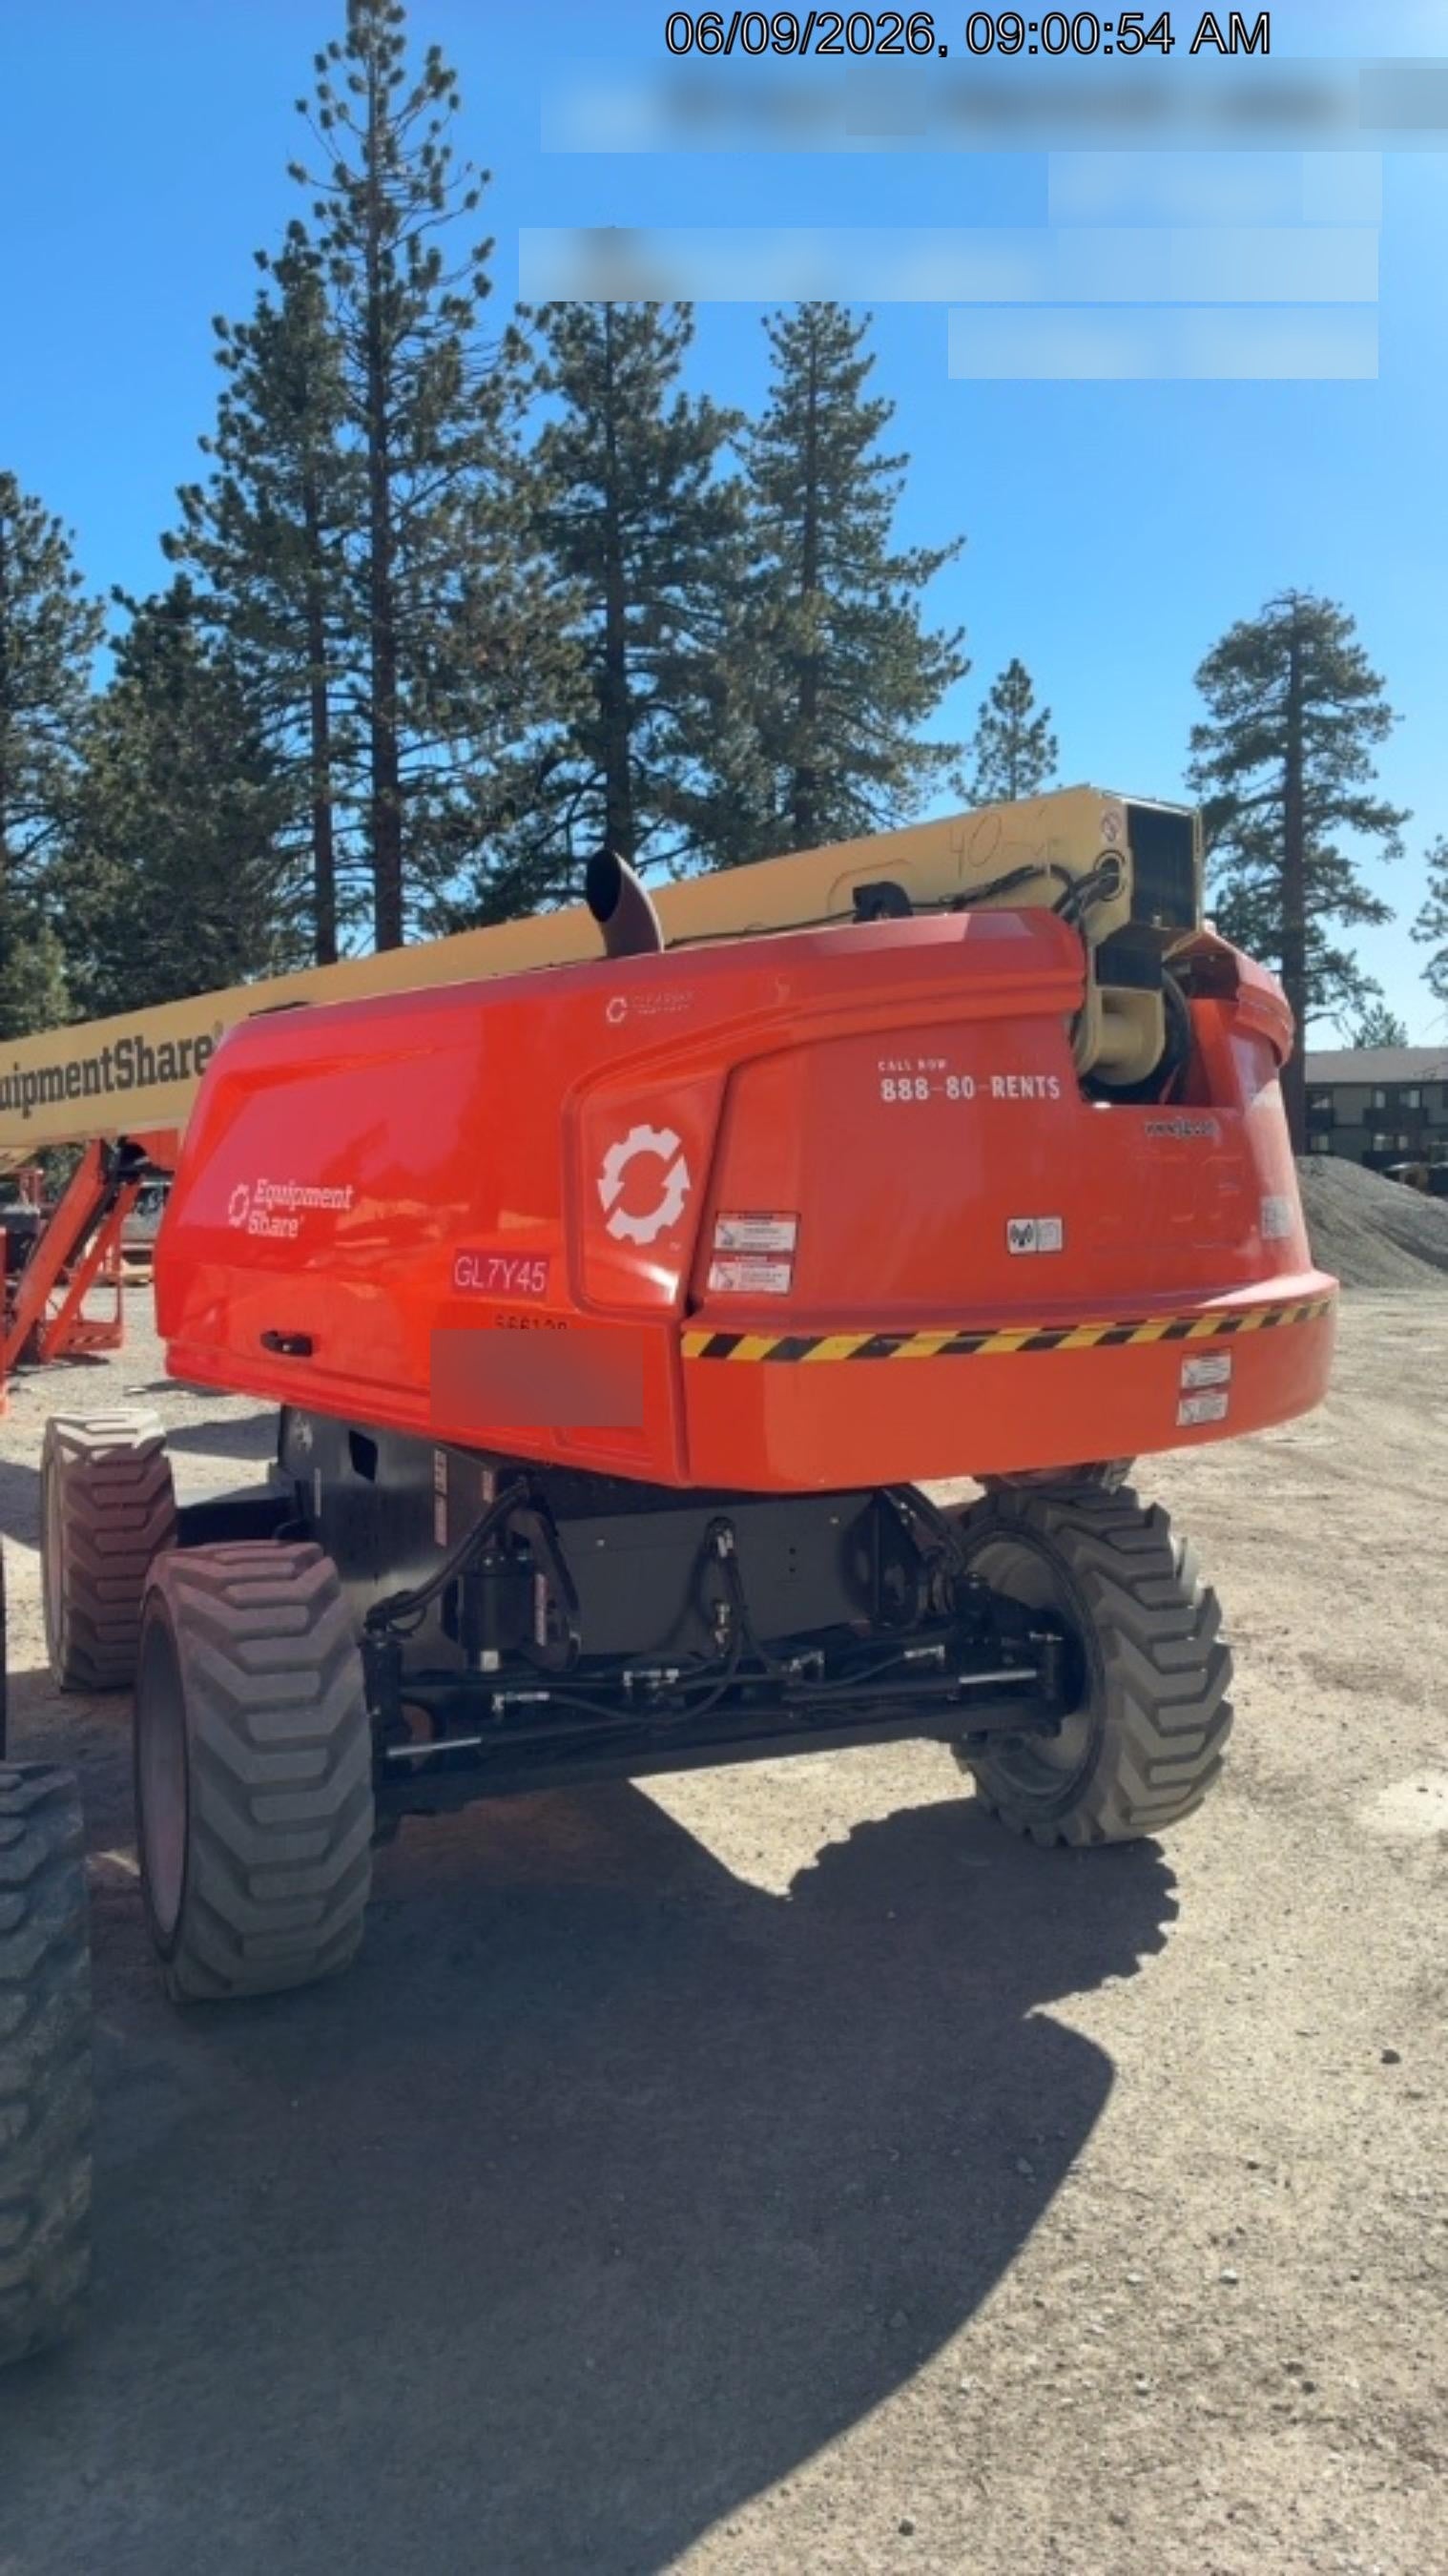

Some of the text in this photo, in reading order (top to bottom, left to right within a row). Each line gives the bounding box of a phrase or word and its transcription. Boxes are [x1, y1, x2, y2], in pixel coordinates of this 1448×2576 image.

[878, 1058, 947, 1071] CALL NOW
[254, 1178, 354, 1212] Equipment
[248, 1209, 300, 1238] Share
[454, 1256, 548, 1292] GL7Y45
